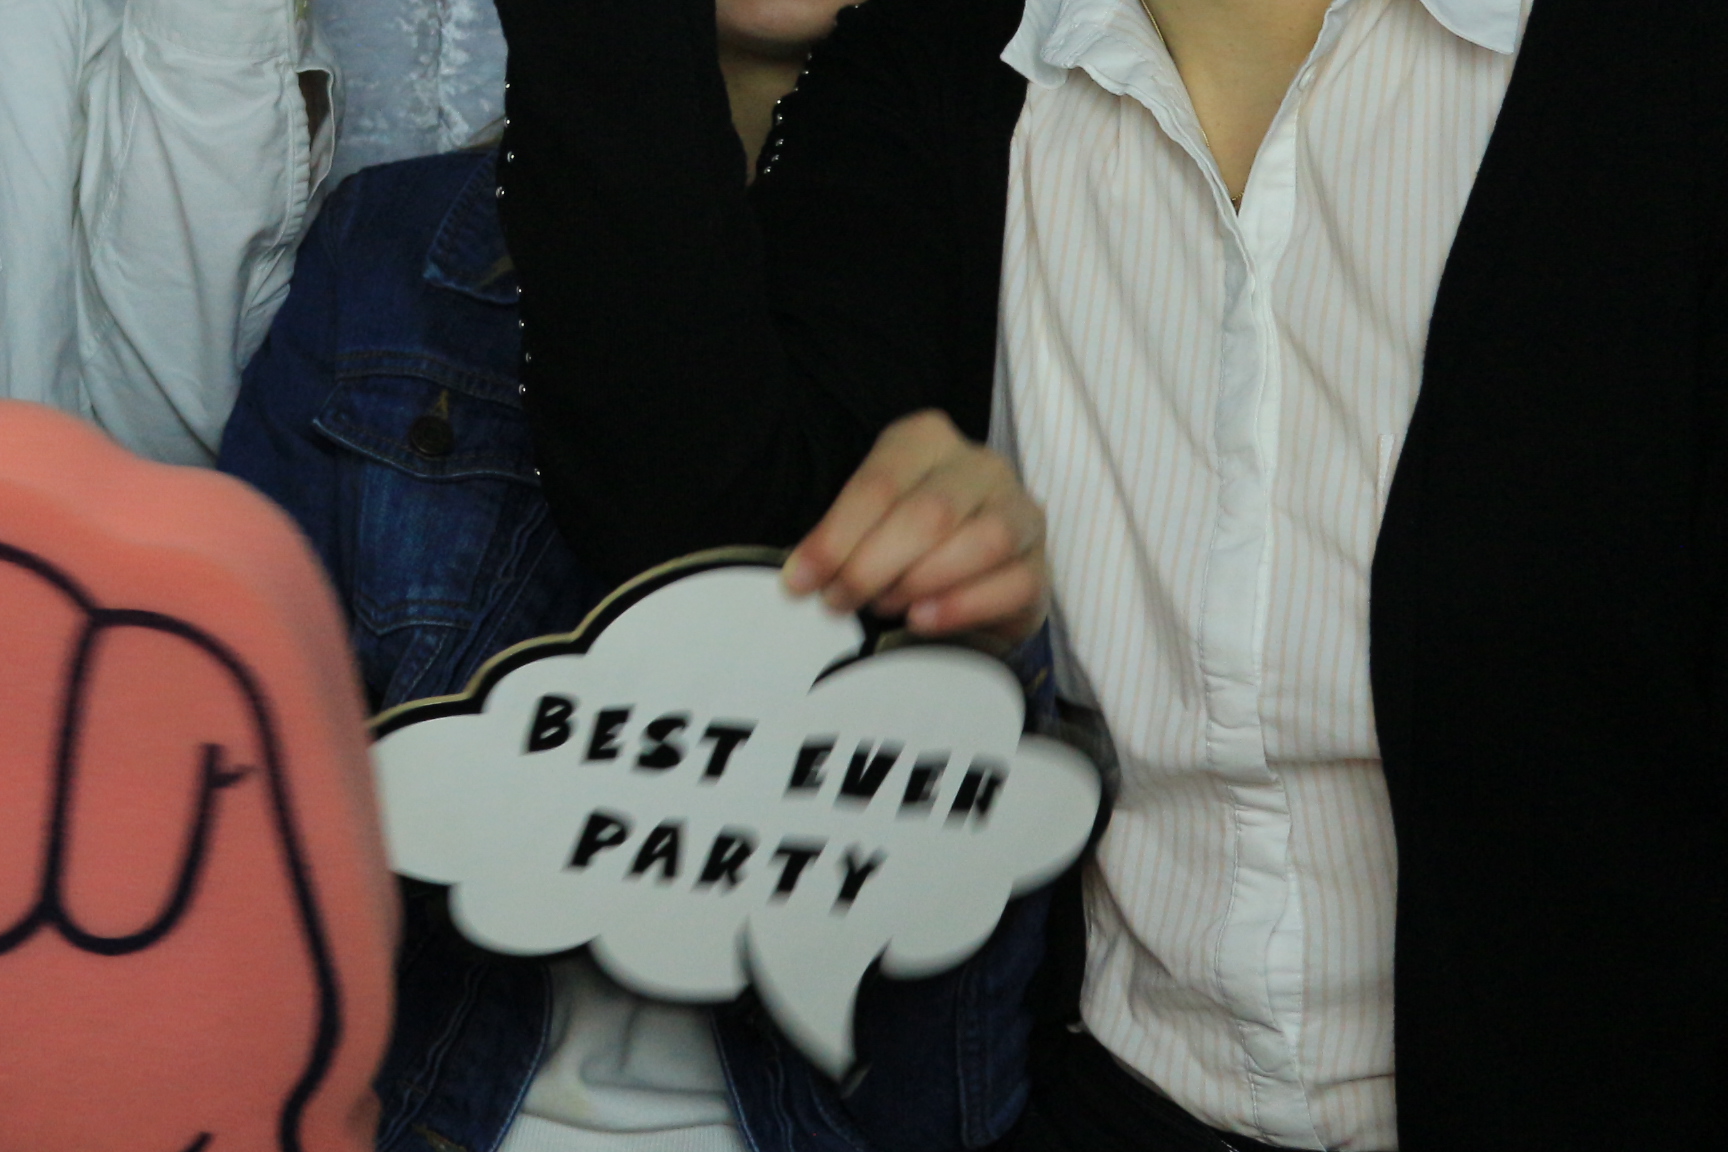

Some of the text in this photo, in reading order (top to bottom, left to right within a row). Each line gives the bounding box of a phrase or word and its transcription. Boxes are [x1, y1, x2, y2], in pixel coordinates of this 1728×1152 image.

[522, 693, 1010, 828] BEST EVER
[564, 807, 888, 915] PARTY
